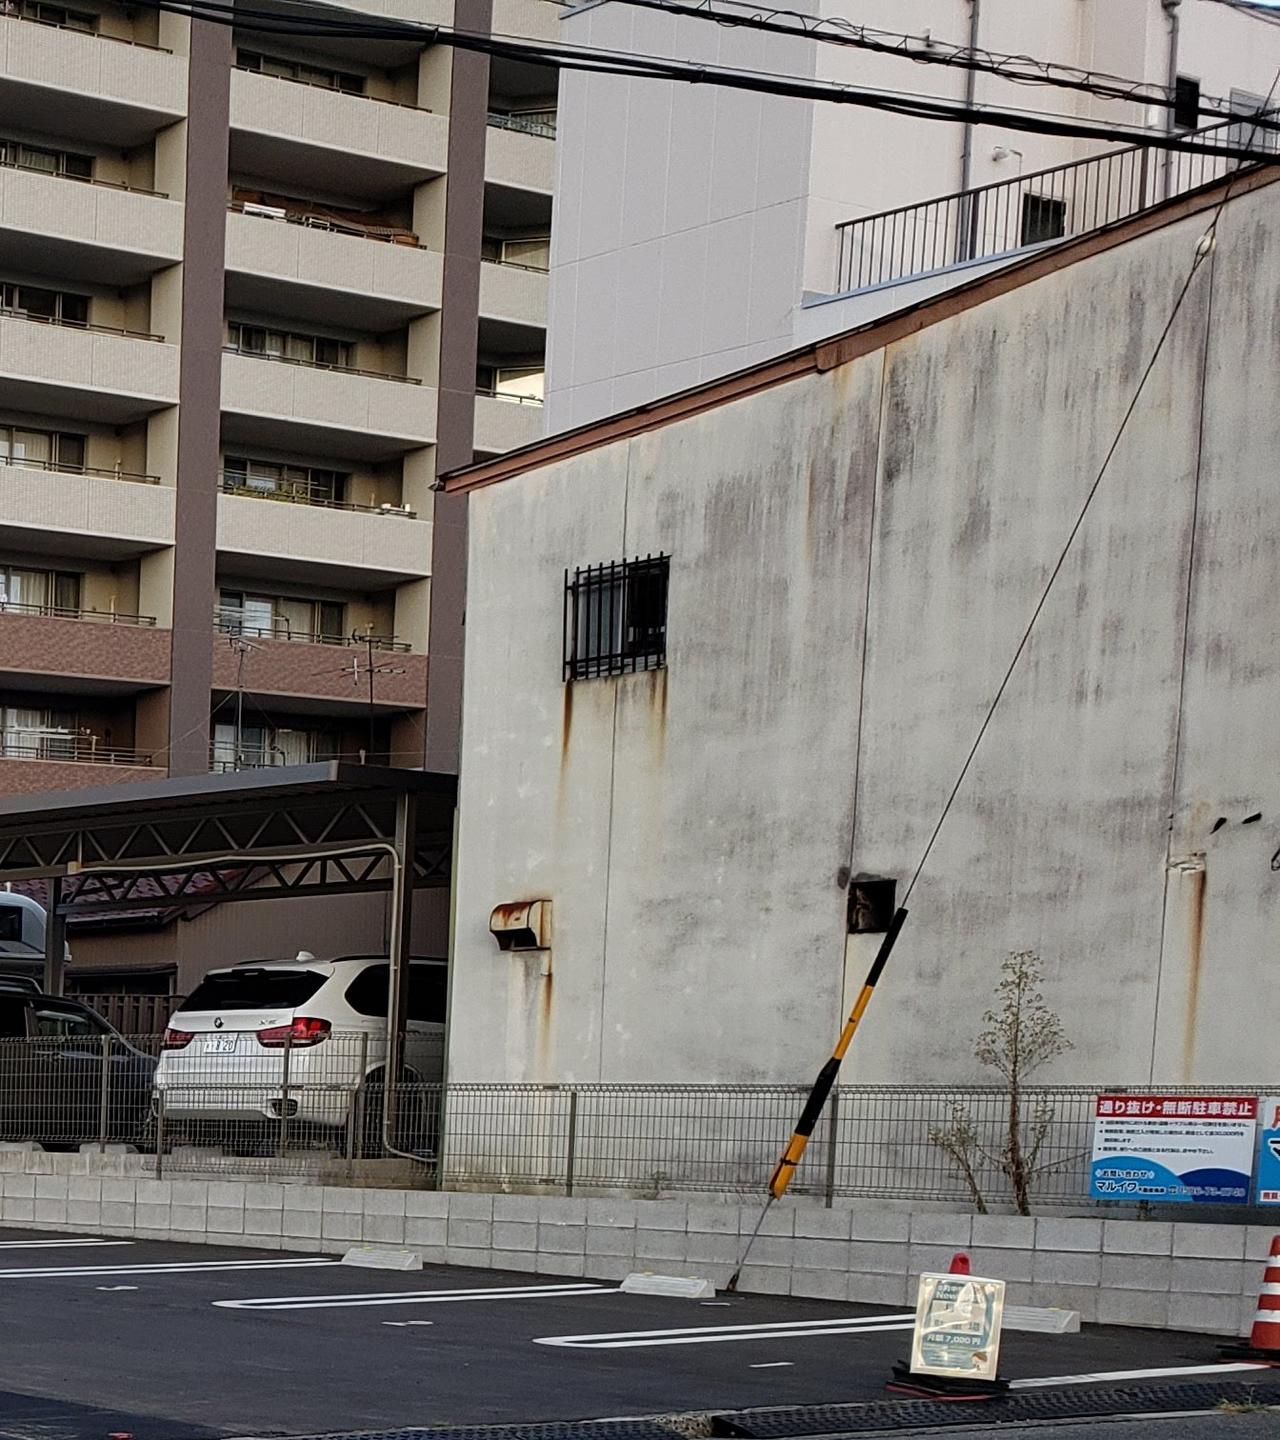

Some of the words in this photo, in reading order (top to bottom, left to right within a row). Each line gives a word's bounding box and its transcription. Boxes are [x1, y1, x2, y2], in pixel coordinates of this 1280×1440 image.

[1099, 1099, 1254, 1116] 通り抜け・無断駐車禁止
